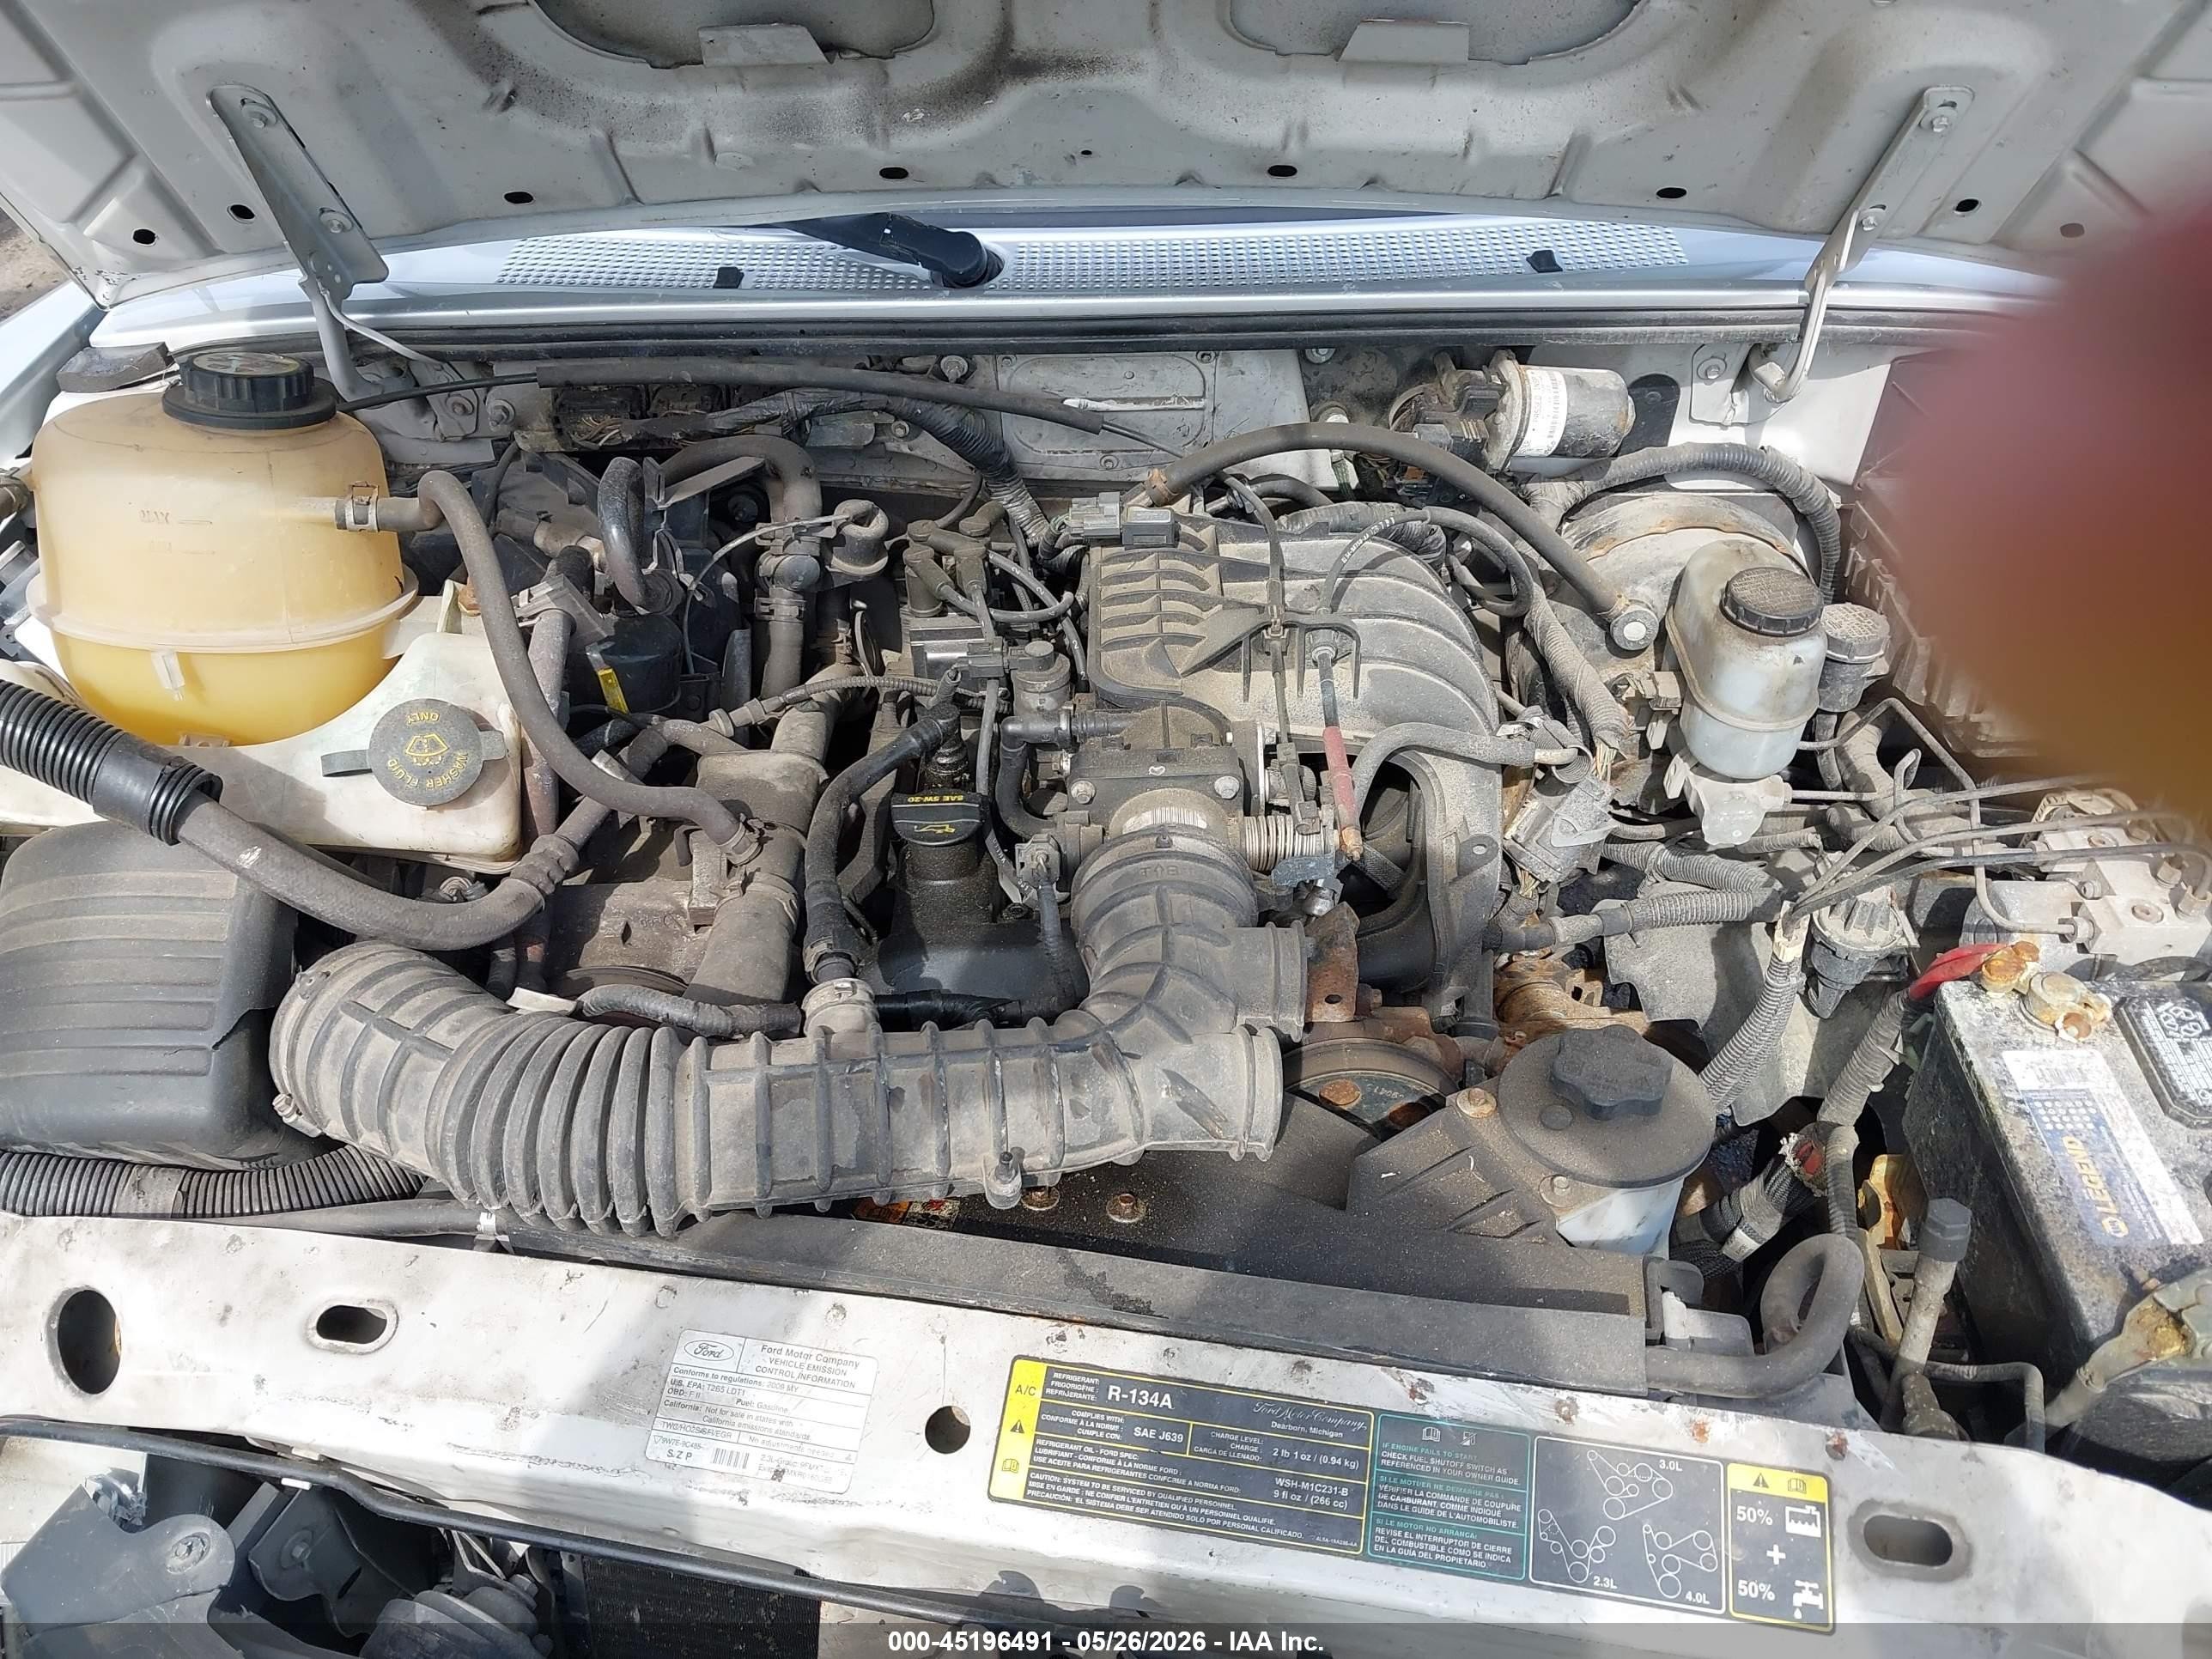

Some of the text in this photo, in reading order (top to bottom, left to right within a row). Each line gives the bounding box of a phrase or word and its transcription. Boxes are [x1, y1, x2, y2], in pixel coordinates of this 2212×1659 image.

[407, 712, 440, 724] ONLY
[388, 752, 468, 789] WASHER FLUID
[2063, 1135, 2119, 1215] LEGEND
[692, 1340, 726, 1358] Ford
[760, 1345, 860, 1369] Ford Company
[768, 1357, 848, 1376] VEHICLE EMISSION
[672, 1366, 709, 1378] Conforms
[720, 1374, 765, 1389] regulations:
[754, 1365, 856, 1388] CONTROL INFORMATION
[1053, 1372, 1099, 1384] REFRIGERANT:
[666, 1387, 687, 1396] OBD:
[686, 1381, 745, 1396] EPA: LDT1
[1015, 1384, 1036, 1396] A/C
[1106, 1384, 1174, 1409] R-134A
[662, 1399, 702, 1412] California:
[704, 1406, 718, 1414] Not
[729, 1410, 745, 1419] sale
[754, 1414, 777, 1424] states
[778, 1418, 794, 1427] with
[1071, 1410, 1124, 1424] COMPLIES WITH:
[1253, 1401, 1313, 1424] Ford Motor
[702, 1415, 773, 1433] California emissions
[1041, 1413, 1078, 1425] CONFORME
[1095, 1422, 1119, 1431] NORME
[1077, 1428, 1104, 1437] CUMPLE
[1133, 1426, 1183, 1443] SAE J639
[1211, 1431, 1264, 1444] CHARGE LEVEL:
[1309, 1427, 1343, 1439] Michigan
[1036, 1438, 1082, 1451] REFRIGERANT
[1230, 1443, 1257, 1452] CHARGE
[684, 1452, 693, 1461] P
[1034, 1447, 1073, 1459] LUBRIFIANT
[1078, 1454, 1115, 1465] CONFORME
[1133, 1462, 1158, 1472] NORME
[1159, 1467, 1178, 1475] FORD
[1194, 1446, 1217, 1455] CARGA
[1228, 1451, 1262, 1462] LLENADO:
[1272, 1448, 1359, 1470] 2 lb 1 oz (0.94 kg)
[1381, 1450, 1407, 1460] CHECK
[1409, 1455, 1428, 1463] FUEL
[1430, 1457, 1463, 1468] SHUTOFF
[1466, 1463, 1496, 1474] SWITCH
[1048, 1458, 1072, 1467] ACEITE
[1073, 1462, 1091, 1470] PARA
[1091, 1465, 1146, 1479] REFRIGERANTES
[1194, 1480, 1218, 1490] NORMA
[1381, 1459, 1431, 1472] REFERENCED
[1442, 1468, 1462, 1477] YOUR
[1465, 1471, 1493, 1481] OWNER
[1659, 1460, 1683, 1472] 3.0L
[1030, 1472, 1062, 1483] CAUTION:
[1062, 1477, 1090, 1487] SYSTEM
[1111, 1485, 1146, 1496] SERVICED
[1157, 1492, 1193, 1504] QUALIFIED
[1274, 1477, 1349, 1497] WSH-M1C231-B
[1028, 1480, 1045, 1489] MISE
[1056, 1485, 1080, 1494] GARDE
[1096, 1492, 1125, 1502] CONFIER
[1126, 1496, 1169, 1509] L'ENTRETIEN
[1200, 1508, 1242, 1520] PERSONNEL
[1273, 1489, 1279, 1498] 9
[1310, 1494, 1330, 1507] (266
[1333, 1498, 1347, 1510] cc)
[1377, 1501, 1398, 1510] DANS
[1411, 1506, 1435, 1516] GUIDE
[1425, 1491, 1469, 1504] COMMANDE
[1484, 1499, 1521, 1512] COUPURE
[1439, 1502, 1468, 1512] COMME
[1085, 1498, 1115, 1509] SISTEMA
[1115, 1504, 1134, 1512] DEBE
[1150, 1509, 1184, 1520] ATENDIDO
[1185, 1514, 1205, 1523] SOLO
[1206, 1517, 1220, 1526] POR
[1221, 1520, 1259, 1532] PERSONAL
[1736, 1505, 1773, 1526] 50%
[1396, 1521, 1424, 1530] MOTOR
[1375, 1526, 1402, 1537] REVISE
[1415, 1533, 1469, 1547] INTERRUPTOR
[1471, 1541, 1480, 1550] DE
[1483, 1544, 1512, 1554] CIERRE
[1391, 1538, 1445, 1553] COMBUSTIBLE
[1447, 1547, 1470, 1557] COMO
[1485, 1553, 1510, 1563] INDICA
[1418, 1551, 1432, 1559] DEL
[1593, 1576, 1618, 1589] 2.3L
[1737, 1580, 1776, 1601] 50%
[1685, 1590, 1711, 1604] 4.0L
